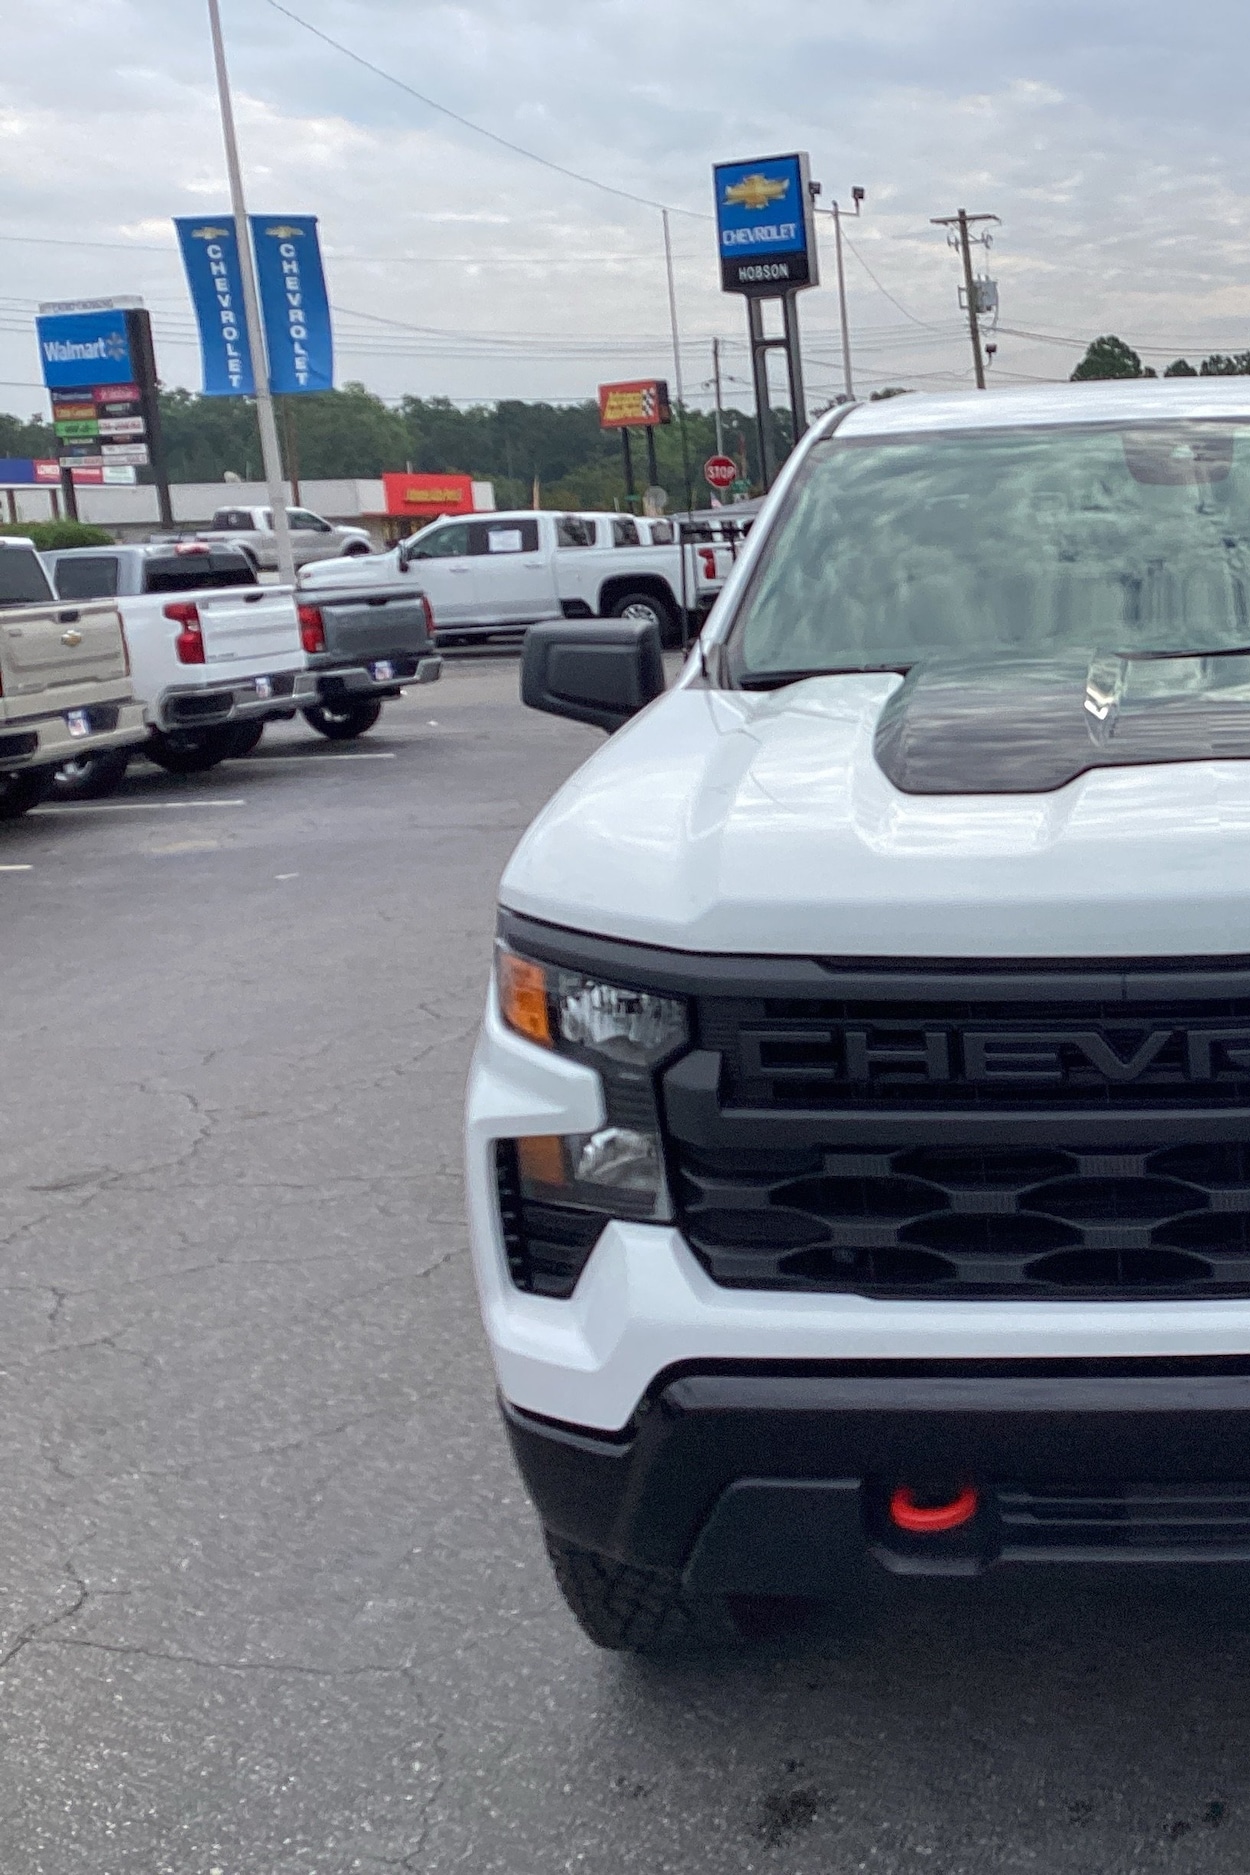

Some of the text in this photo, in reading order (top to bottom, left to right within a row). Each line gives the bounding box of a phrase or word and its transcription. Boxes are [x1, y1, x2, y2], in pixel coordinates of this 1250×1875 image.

[722, 223, 796, 247] CHEVROLET
[738, 263, 789, 282] HOBSON
[207, 243, 243, 389] CHEVROLET
[279, 243, 310, 387] CHEVROLET
[43, 337, 107, 362] Walmart
[707, 465, 735, 480] STOP
